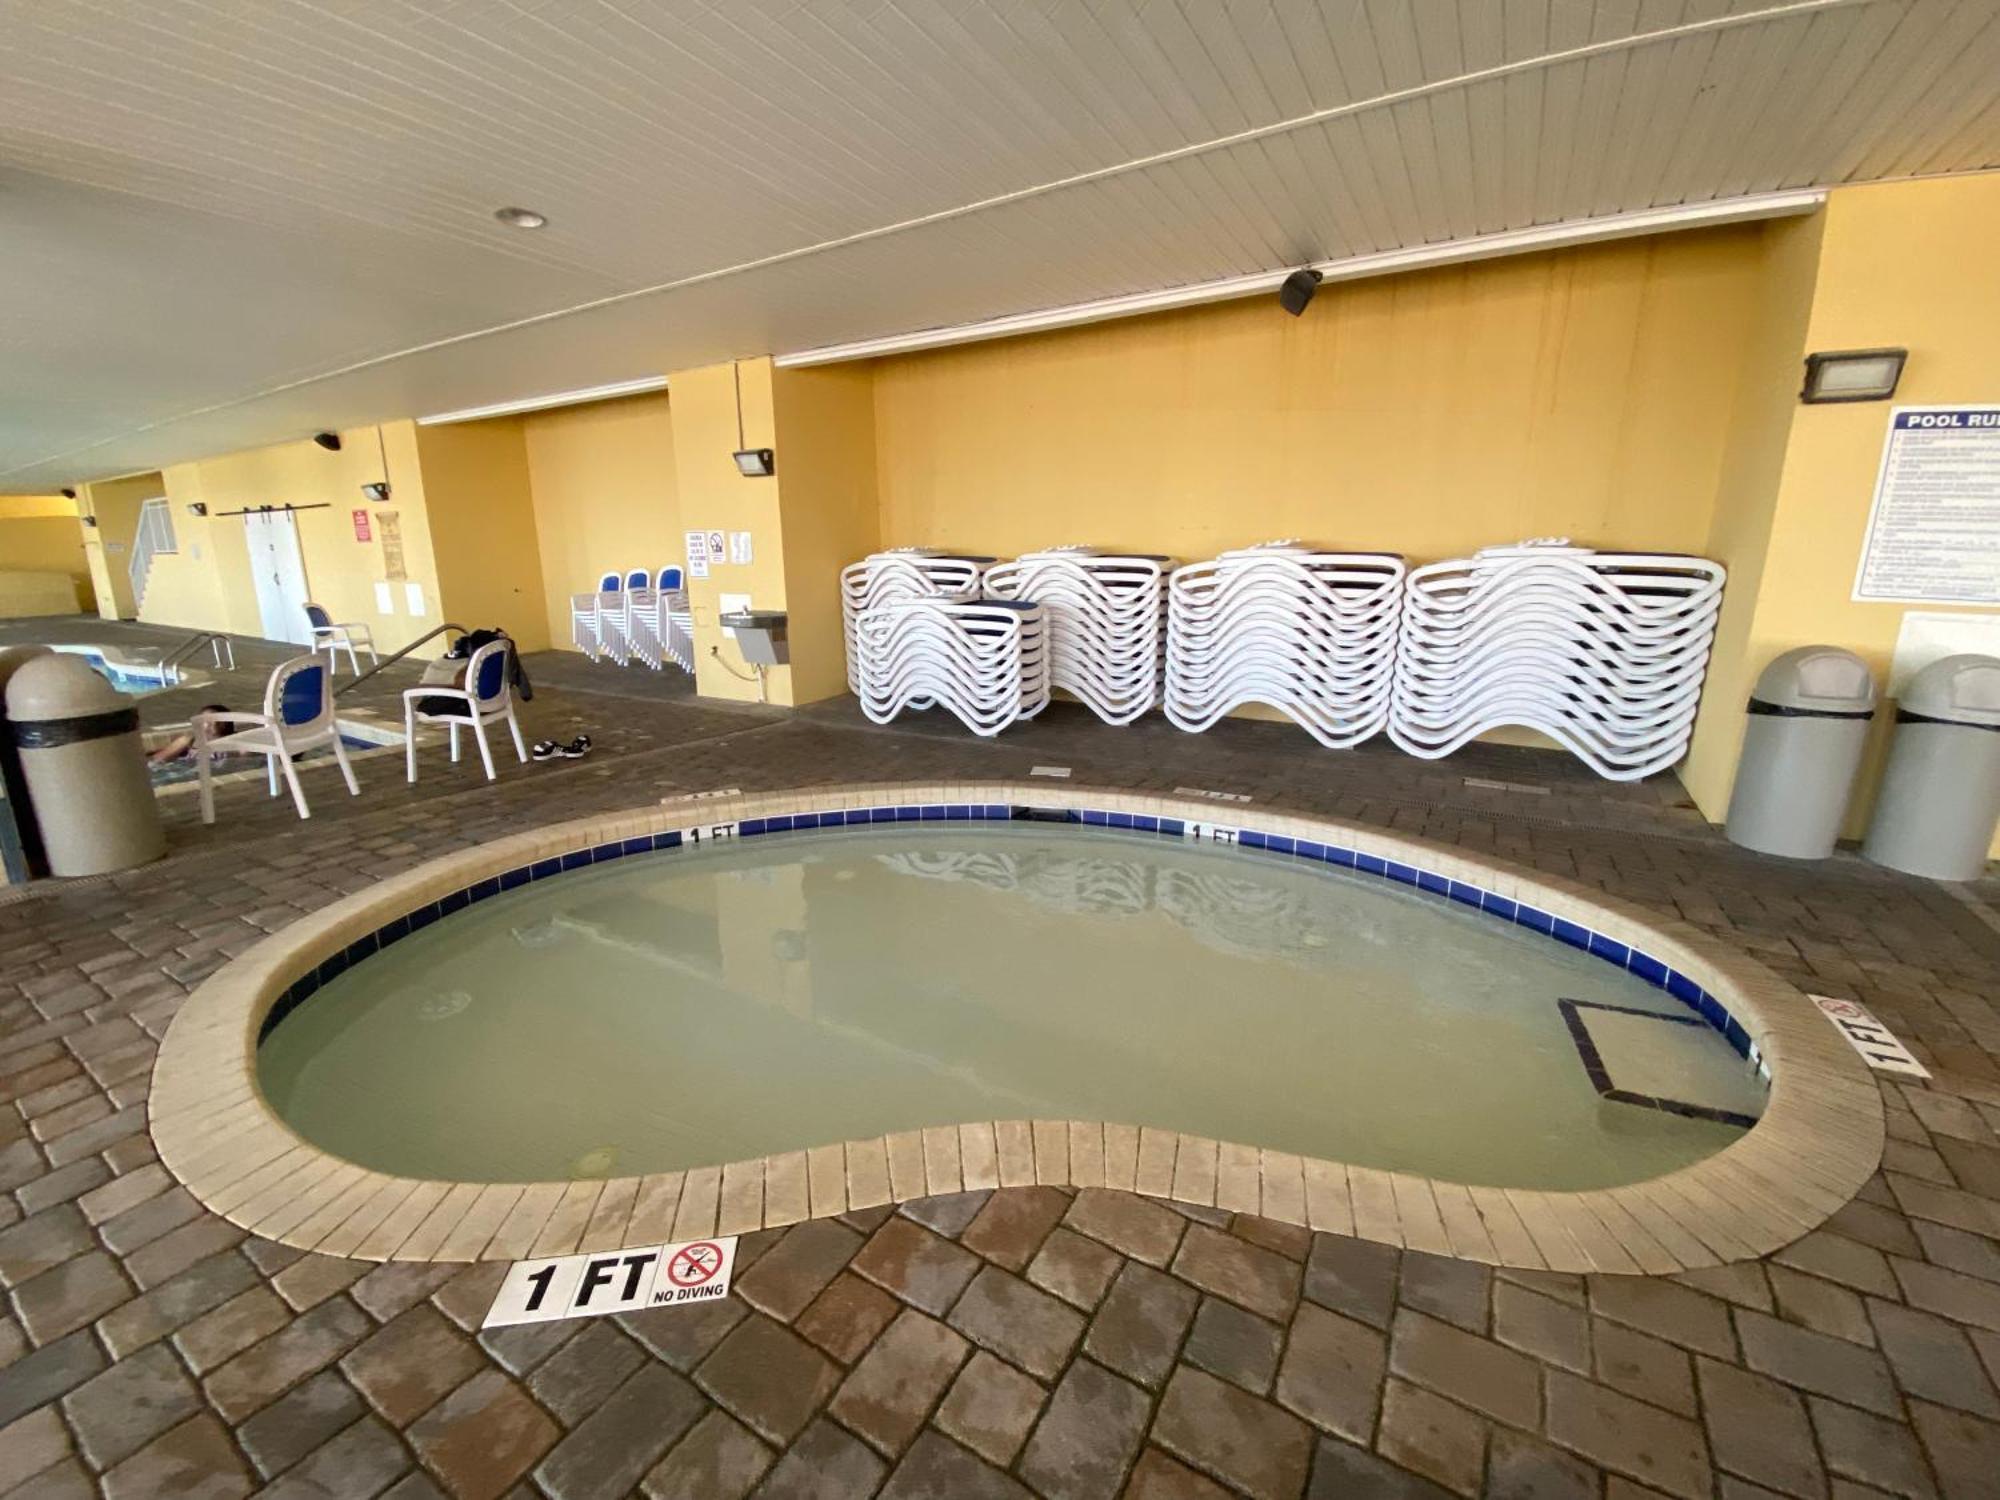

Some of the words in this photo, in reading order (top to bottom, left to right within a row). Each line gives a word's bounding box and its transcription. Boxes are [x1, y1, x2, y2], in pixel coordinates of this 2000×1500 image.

[1907, 415, 1962, 427] POOL
[690, 828, 699, 843] 1
[711, 824, 734, 839] FT
[1193, 824, 1201, 838] 1
[1213, 829, 1235, 842] FT
[1837, 1018, 1897, 1048] FT
[1866, 1051, 1911, 1064] 1
[525, 1264, 558, 1312] 1
[575, 1253, 657, 1307] FT
[653, 1290, 674, 1303] NO
[677, 1284, 724, 1300] DIVING
